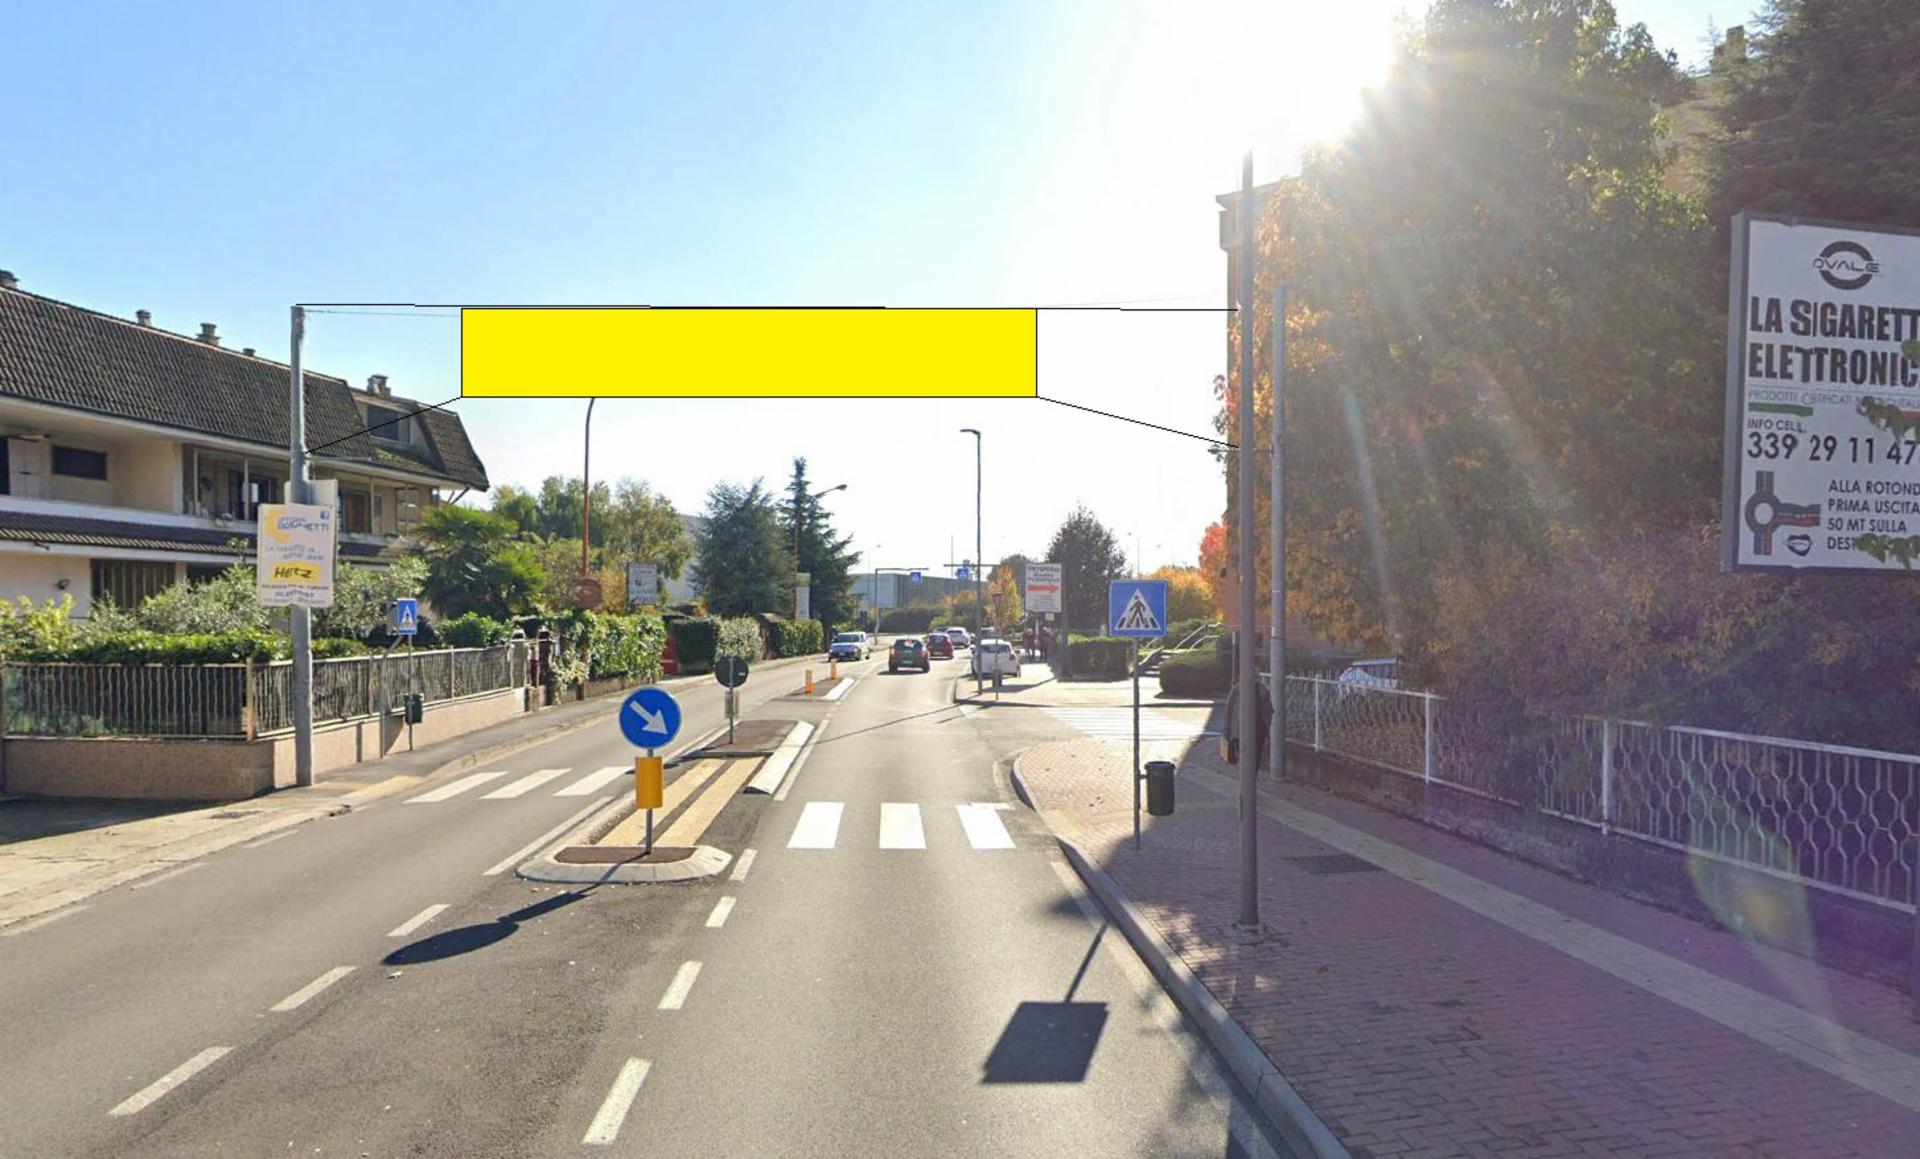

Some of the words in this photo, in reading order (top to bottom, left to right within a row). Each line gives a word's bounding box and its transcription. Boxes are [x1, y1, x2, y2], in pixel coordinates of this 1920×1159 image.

[1812, 258, 1881, 273] OVALE
[1751, 296, 1783, 333] LA
[1748, 419, 1773, 430] INFO
[1748, 431, 1797, 459] 339
[1809, 434, 1837, 461] 29
[1850, 437, 1874, 463] 11
[1887, 440, 1917, 465] 47
[1828, 480, 1861, 493] ALLA
[1828, 499, 1870, 512] PRIMA
[1875, 500, 1920, 514] USCITA
[1847, 519, 1865, 531] MT
[1869, 519, 1907, 533] SULLA
